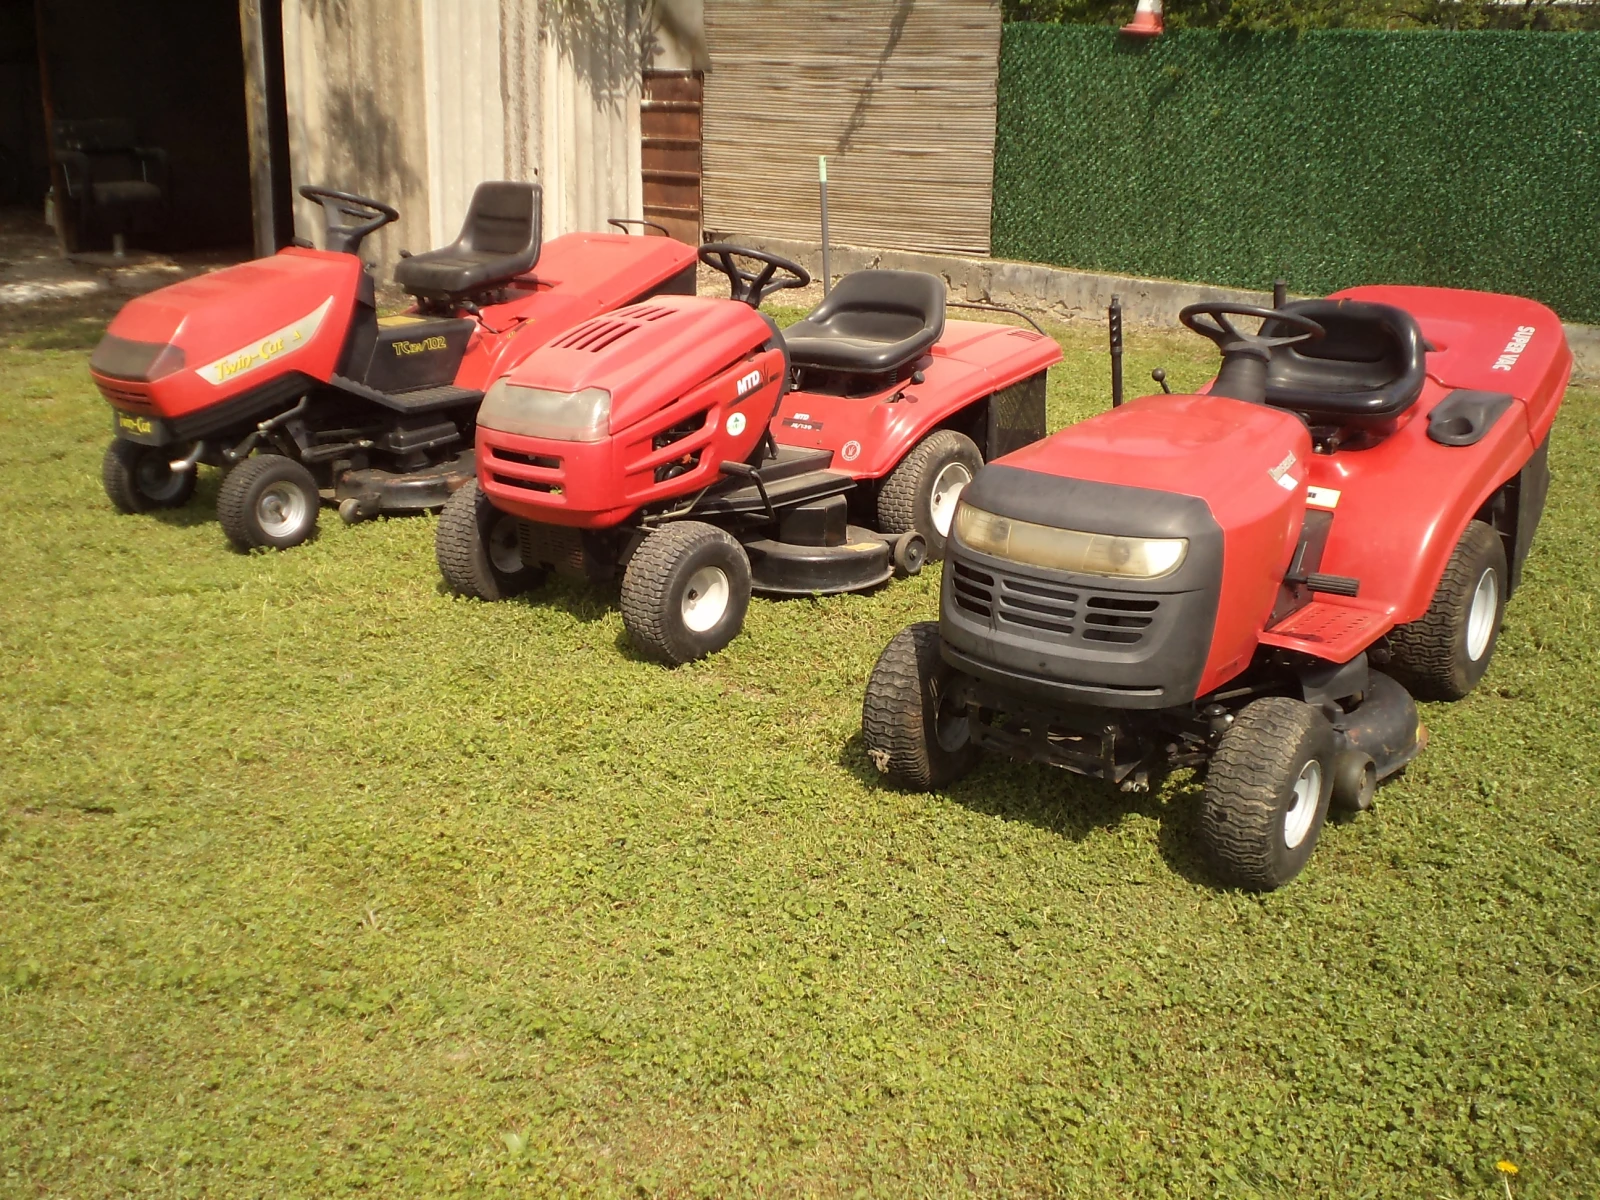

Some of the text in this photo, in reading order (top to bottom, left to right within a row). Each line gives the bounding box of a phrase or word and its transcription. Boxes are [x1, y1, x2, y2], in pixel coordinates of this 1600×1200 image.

[214, 337, 284, 381] Twin-Cut
[1492, 325, 1536, 371] SUPER VAC
[736, 369, 761, 396] MTD
[793, 412, 810, 421] MTD
